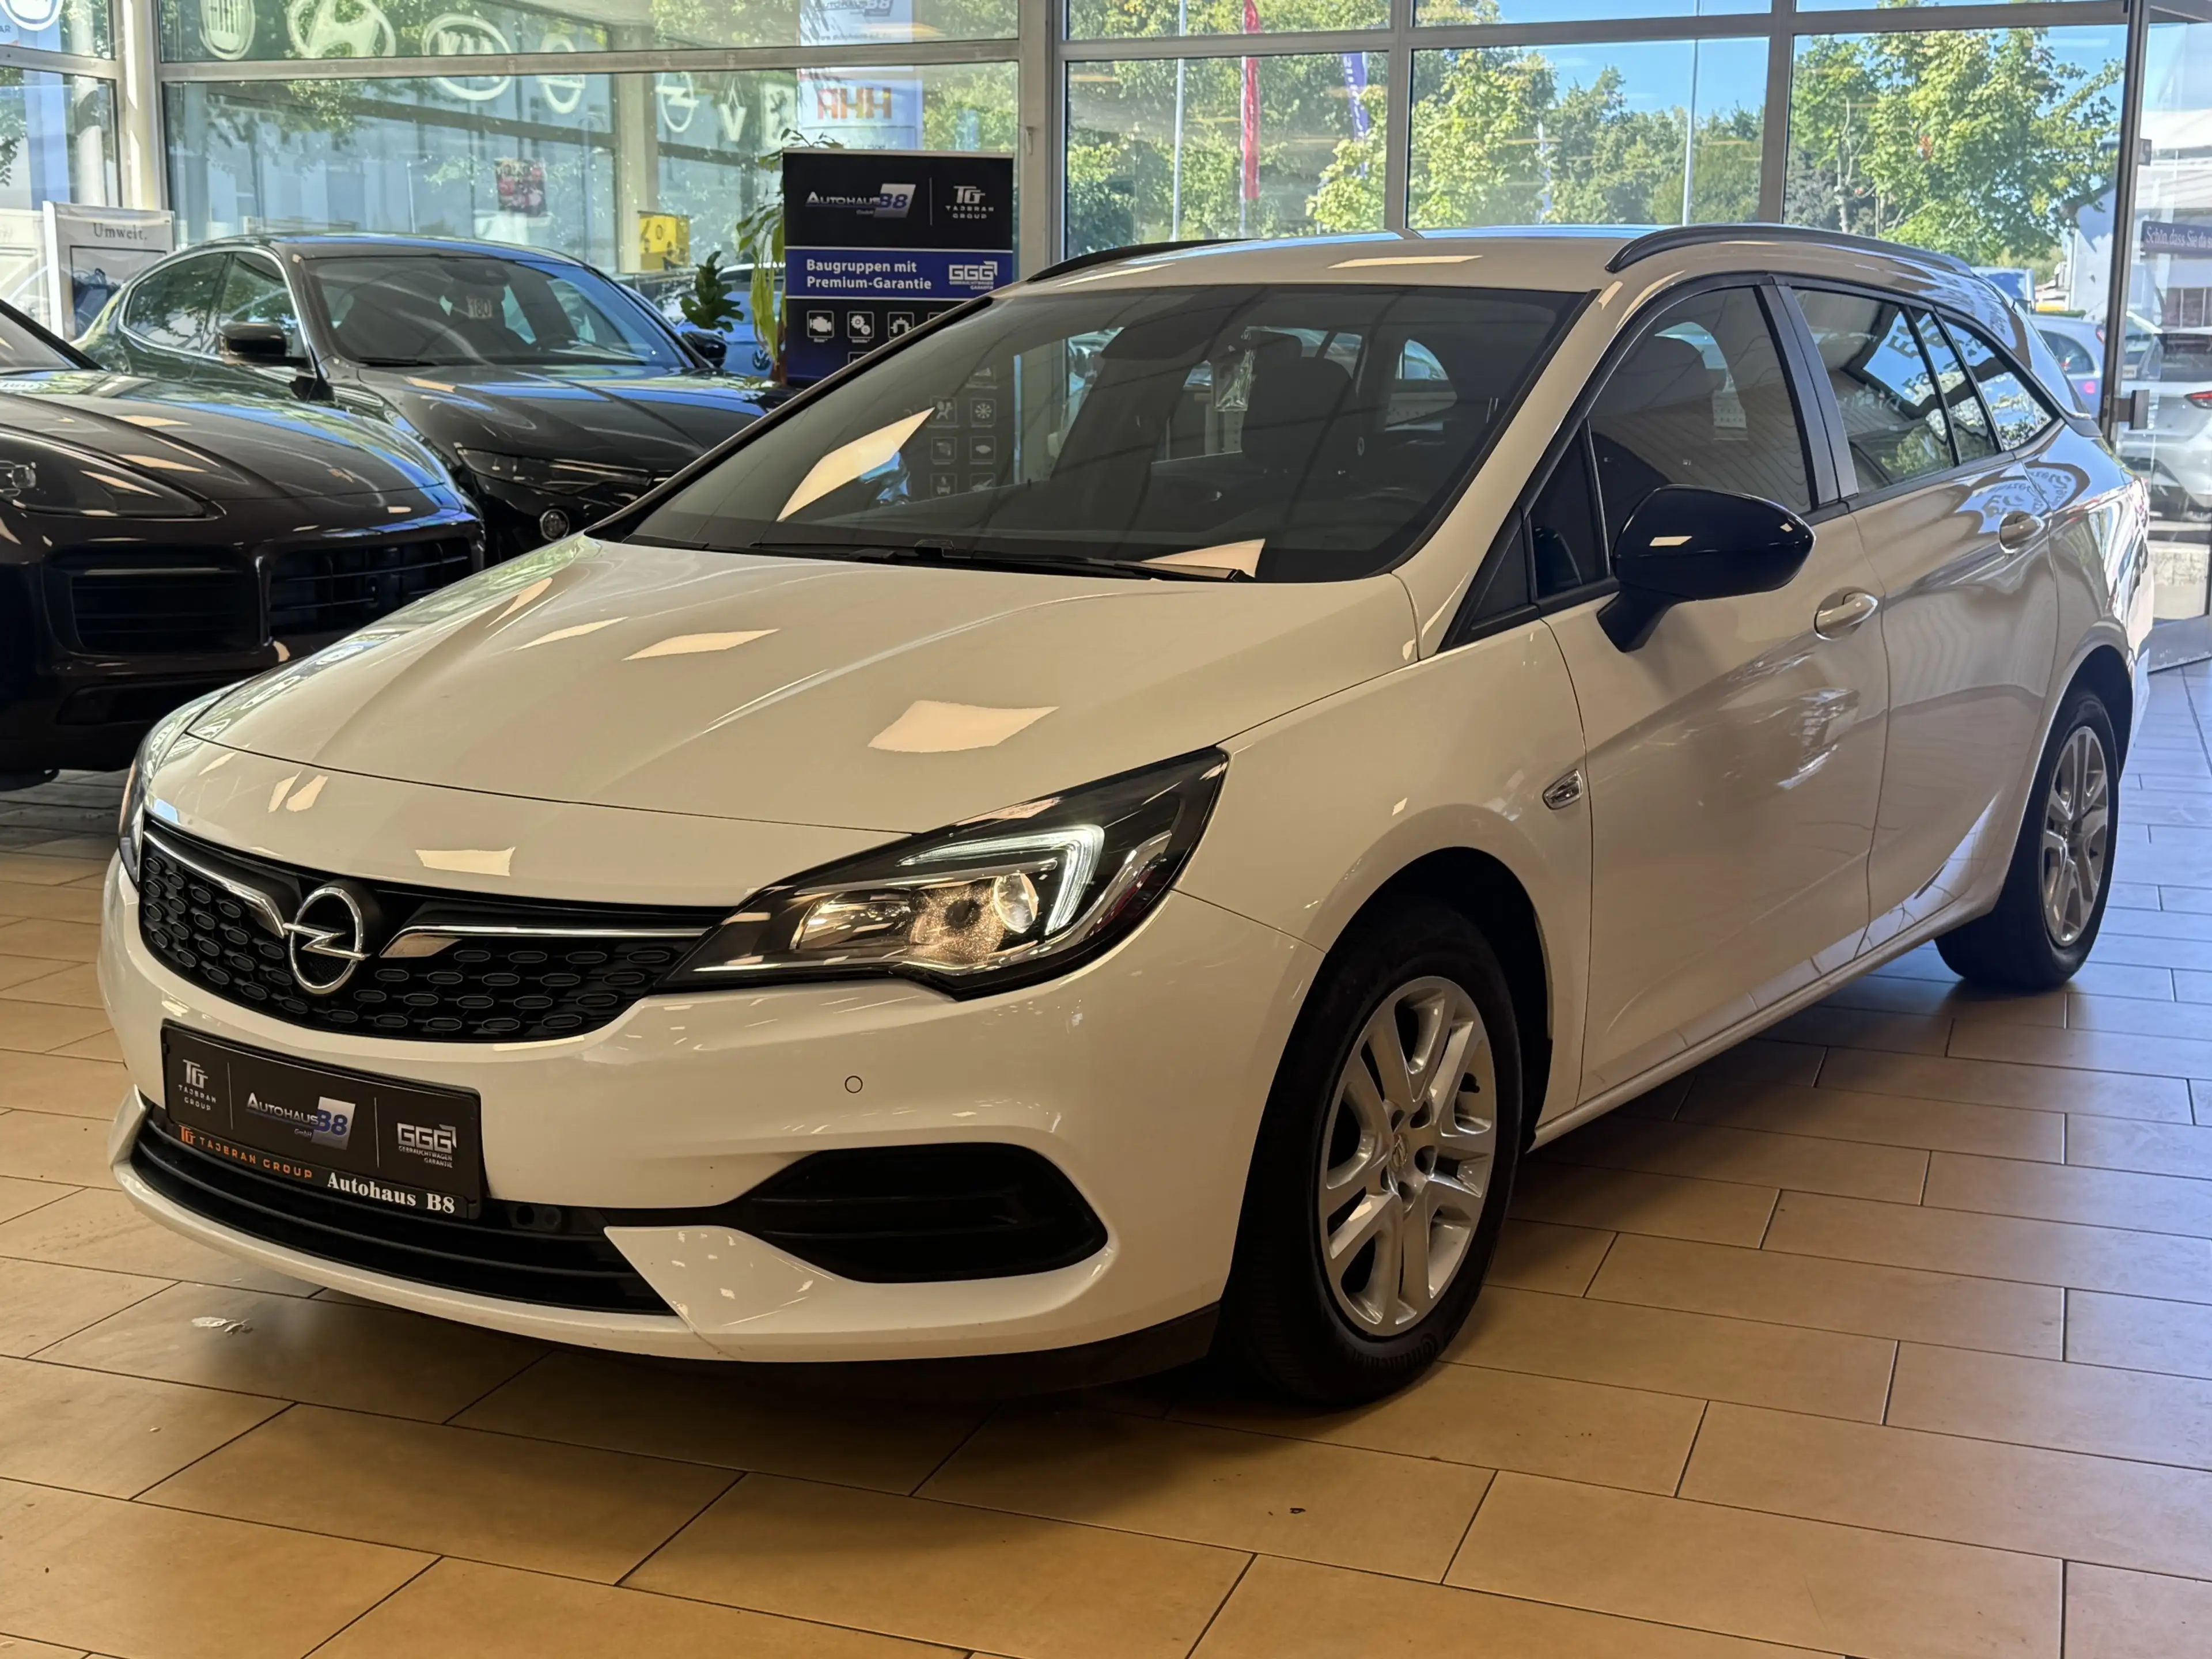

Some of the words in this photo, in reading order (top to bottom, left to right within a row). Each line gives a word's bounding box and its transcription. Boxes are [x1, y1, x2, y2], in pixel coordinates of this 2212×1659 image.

[93, 222, 147, 240] Umwelt.
[806, 259, 891, 274] Baugruppen
[894, 260, 917, 272] mit
[807, 276, 932, 289] Premium-Garantie
[184, 1096, 211, 1111] GROUP
[317, 1109, 348, 1135] B8
[263, 1158, 312, 1179] GROUP
[327, 1172, 416, 1207] Autohaus
[426, 1192, 455, 1214] B8
